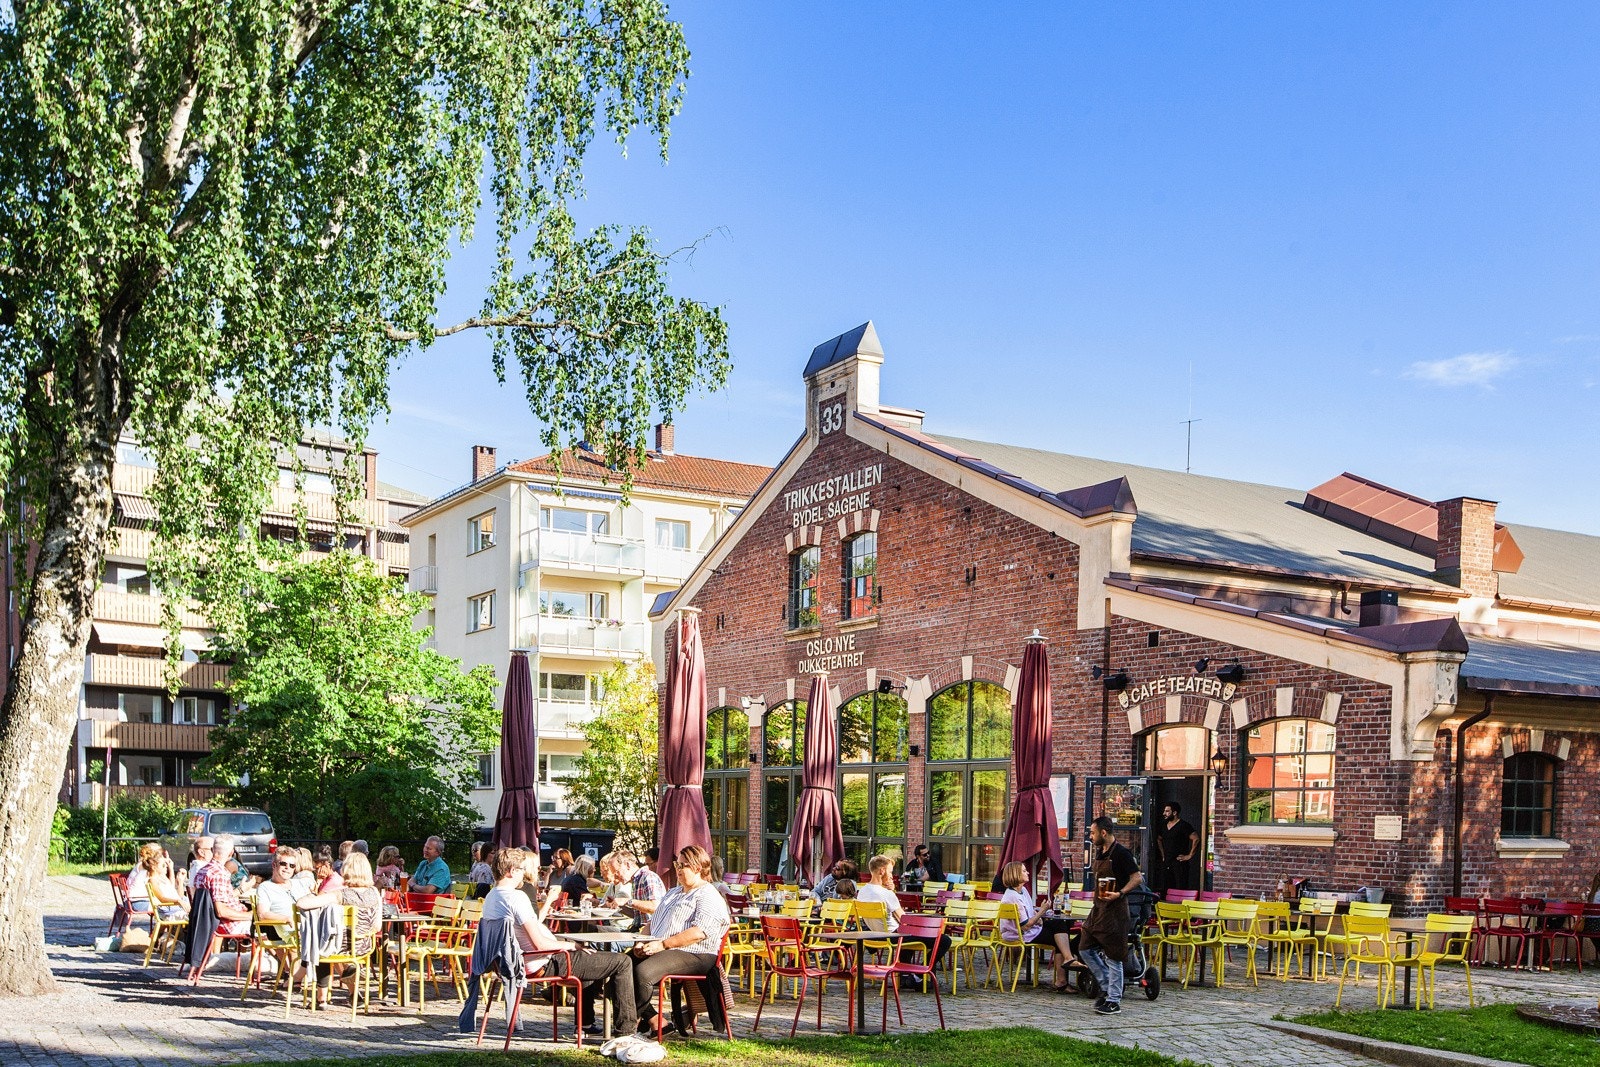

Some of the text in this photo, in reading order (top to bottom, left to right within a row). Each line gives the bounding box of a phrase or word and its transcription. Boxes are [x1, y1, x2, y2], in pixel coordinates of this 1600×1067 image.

[822, 402, 843, 435] 33
[784, 463, 882, 512] TRIKKESTALLEN
[793, 491, 871, 529] BYDEL SAGENE
[806, 634, 856, 657] OSLO NYE
[798, 651, 865, 674] DUKKETEATRET
